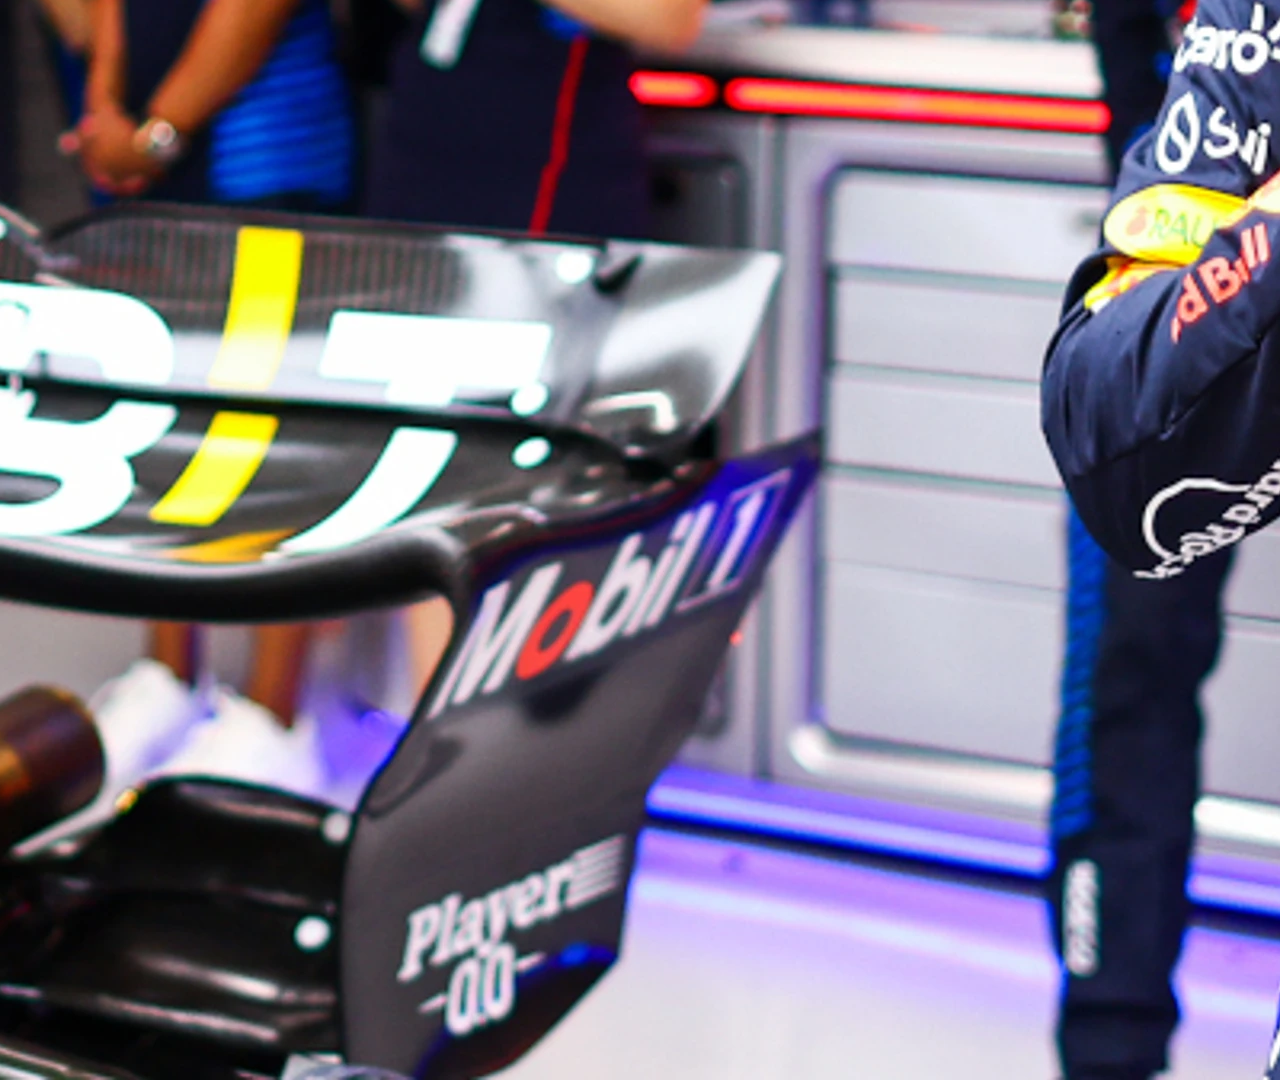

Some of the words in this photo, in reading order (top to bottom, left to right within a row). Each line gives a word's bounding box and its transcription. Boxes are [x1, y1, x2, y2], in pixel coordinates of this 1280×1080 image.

[1147, 207, 1219, 249] RAU
[428, 500, 717, 720] Mobil
[397, 860, 577, 983] Player
